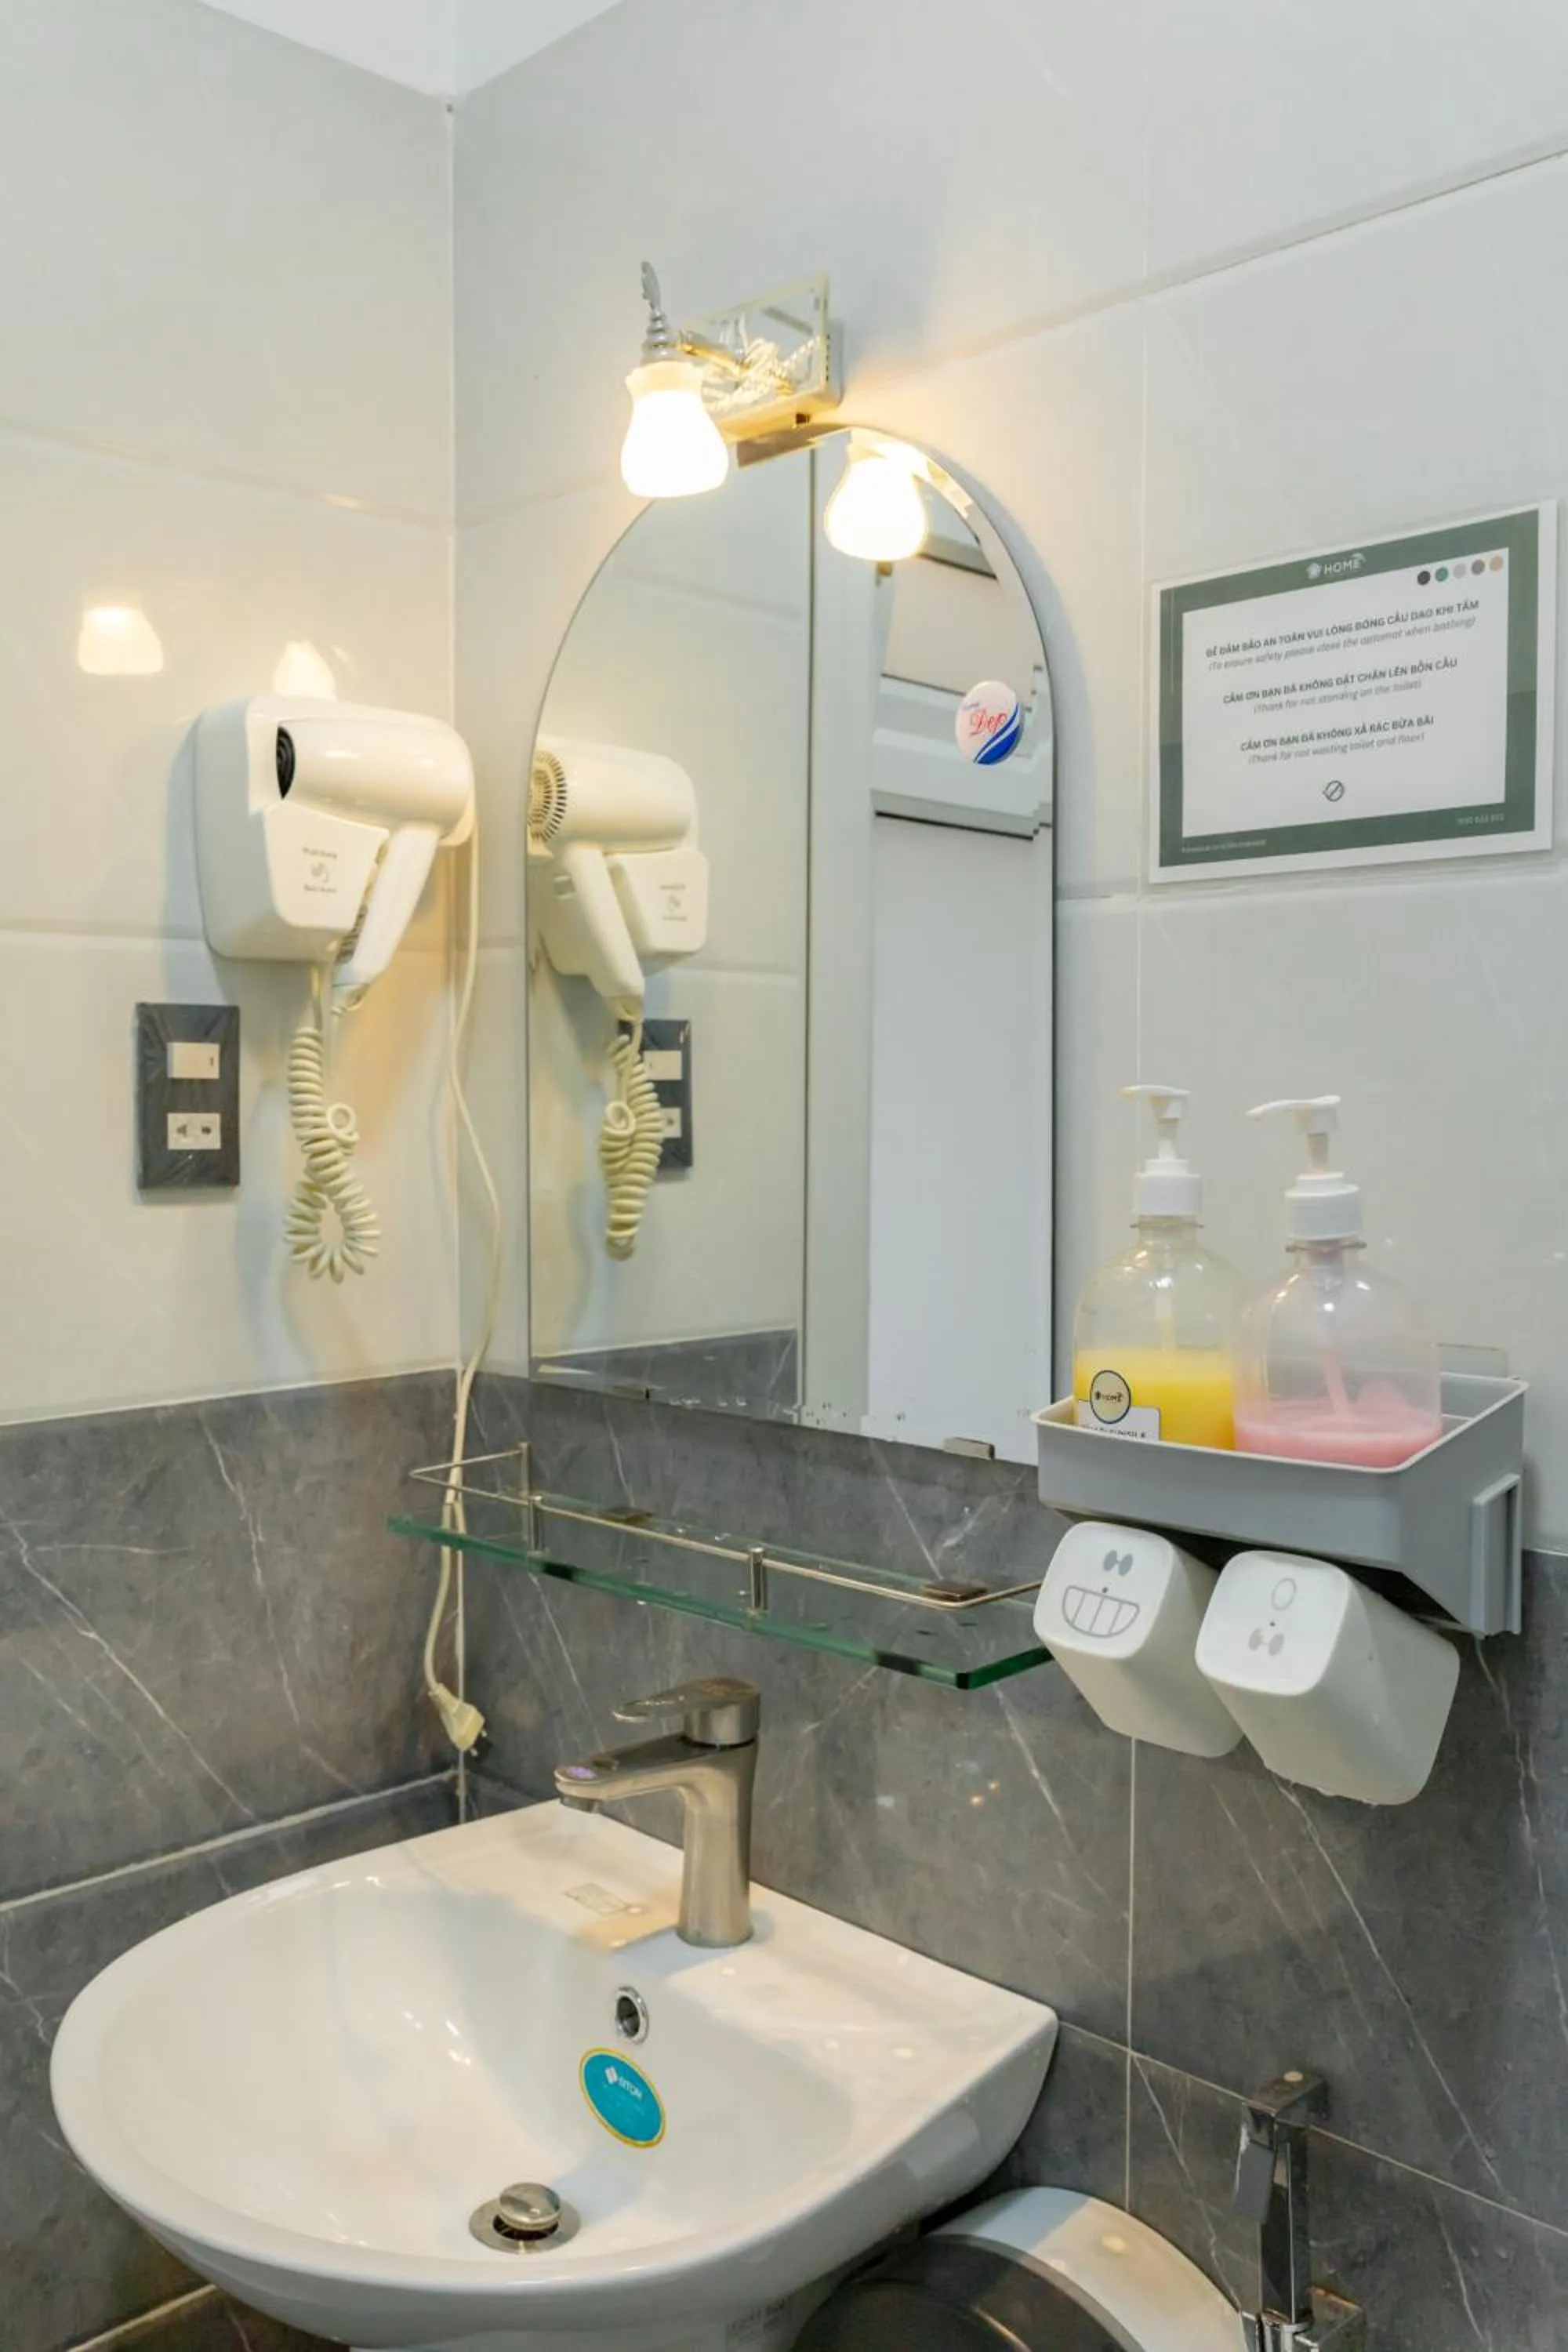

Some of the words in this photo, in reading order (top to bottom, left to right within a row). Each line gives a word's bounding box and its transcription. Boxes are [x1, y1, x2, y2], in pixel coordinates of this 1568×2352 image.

[1324, 559, 1361, 575] HOME
[1264, 637, 1276, 647] AN
[1307, 629, 1323, 640] VUI
[1436, 604, 1454, 617] KHI
